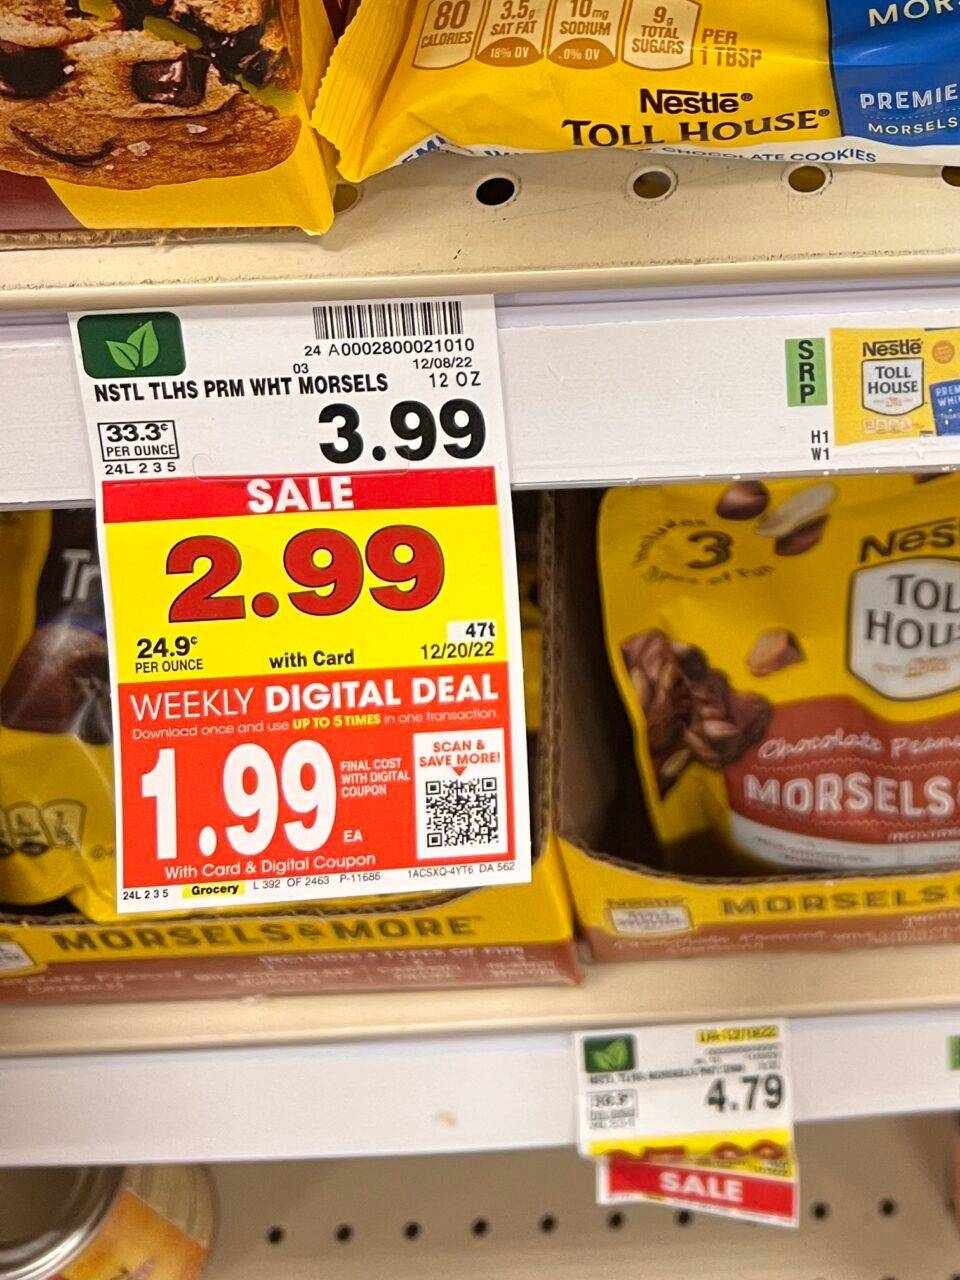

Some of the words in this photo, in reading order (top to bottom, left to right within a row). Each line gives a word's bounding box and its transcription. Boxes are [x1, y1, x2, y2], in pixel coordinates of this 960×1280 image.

[434, 0, 471, 29] 80
[490, 22, 513, 35] SAT
[516, 20, 536, 34] FAT
[560, 21, 611, 36] SODIUM
[641, 26, 679, 40] TOTAL
[420, 31, 473, 48] CALORIES
[702, 29, 737, 44] PER
[631, 39, 684, 55] SUGARS
[713, 49, 762, 69] TBSP
[561, 120, 664, 147] TOLL
[868, 116, 958, 134] MORSELS
[787, 148, 876, 163] COOKIES
[413, 357, 472, 370] 12/08/22
[875, 366, 911, 379] TOLL
[94, 384, 144, 403] NSTL
[149, 381, 198, 400] TLHS
[204, 379, 244, 398] PRM
[250, 377, 292, 396] WHT
[299, 373, 388, 394] MORSELS
[429, 373, 448, 388] 12
[456, 371, 481, 387] OZ
[868, 381, 918, 394] HOUSE
[318, 399, 486, 464] 3.99
[107, 445, 130, 456] PER
[134, 444, 176, 456] OUNCE
[248, 475, 355, 512] SALE
[686, 530, 733, 569] 3
[165, 525, 445, 623] 2.99
[269, 653, 308, 669] with
[313, 650, 355, 666] Card
[420, 642, 495, 660] 12/20/22
[135, 661, 159, 673] PER
[163, 659, 203, 671] OUNCE
[130, 688, 253, 721] WEEKLY
[266, 682, 401, 713] DIGITAL
[412, 674, 499, 705] DEAL
[133, 726, 198, 740] Download
[202, 724, 233, 736] once
[238, 721, 263, 733] and
[267, 721, 289, 732] use
[293, 718, 311, 730] UP
[313, 717, 331, 729] TO
[334, 716, 342, 728] 5
[345, 714, 381, 727] TIMES
[385, 713, 395, 724] in
[398, 711, 422, 723] one
[426, 707, 496, 721] transaction
[433, 740, 472, 752] SCAN
[341, 760, 369, 771] FINAL
[372, 758, 402, 769] COST
[419, 754, 452, 767] SAVE
[456, 751, 501, 764] MORE!
[341, 772, 368, 784] WITH
[371, 770, 410, 782] DIGITAL
[341, 784, 387, 796] COUPON
[141, 739, 337, 860] 1.99
[343, 829, 363, 843] EA
[165, 865, 198, 880] With
[203, 863, 242, 877] Card
[246, 860, 257, 873] &
[261, 858, 309, 876] Digital
[313, 854, 376, 871] Coupon
[191, 883, 239, 896] Grocery
[262, 879, 280, 889] 392
[287, 878, 302, 887] OF
[305, 876, 329, 886] 2463
[340, 872, 381, 884] P-11686
[706, 1074, 783, 1112] 4.79
[660, 1172, 743, 1202] SALE
